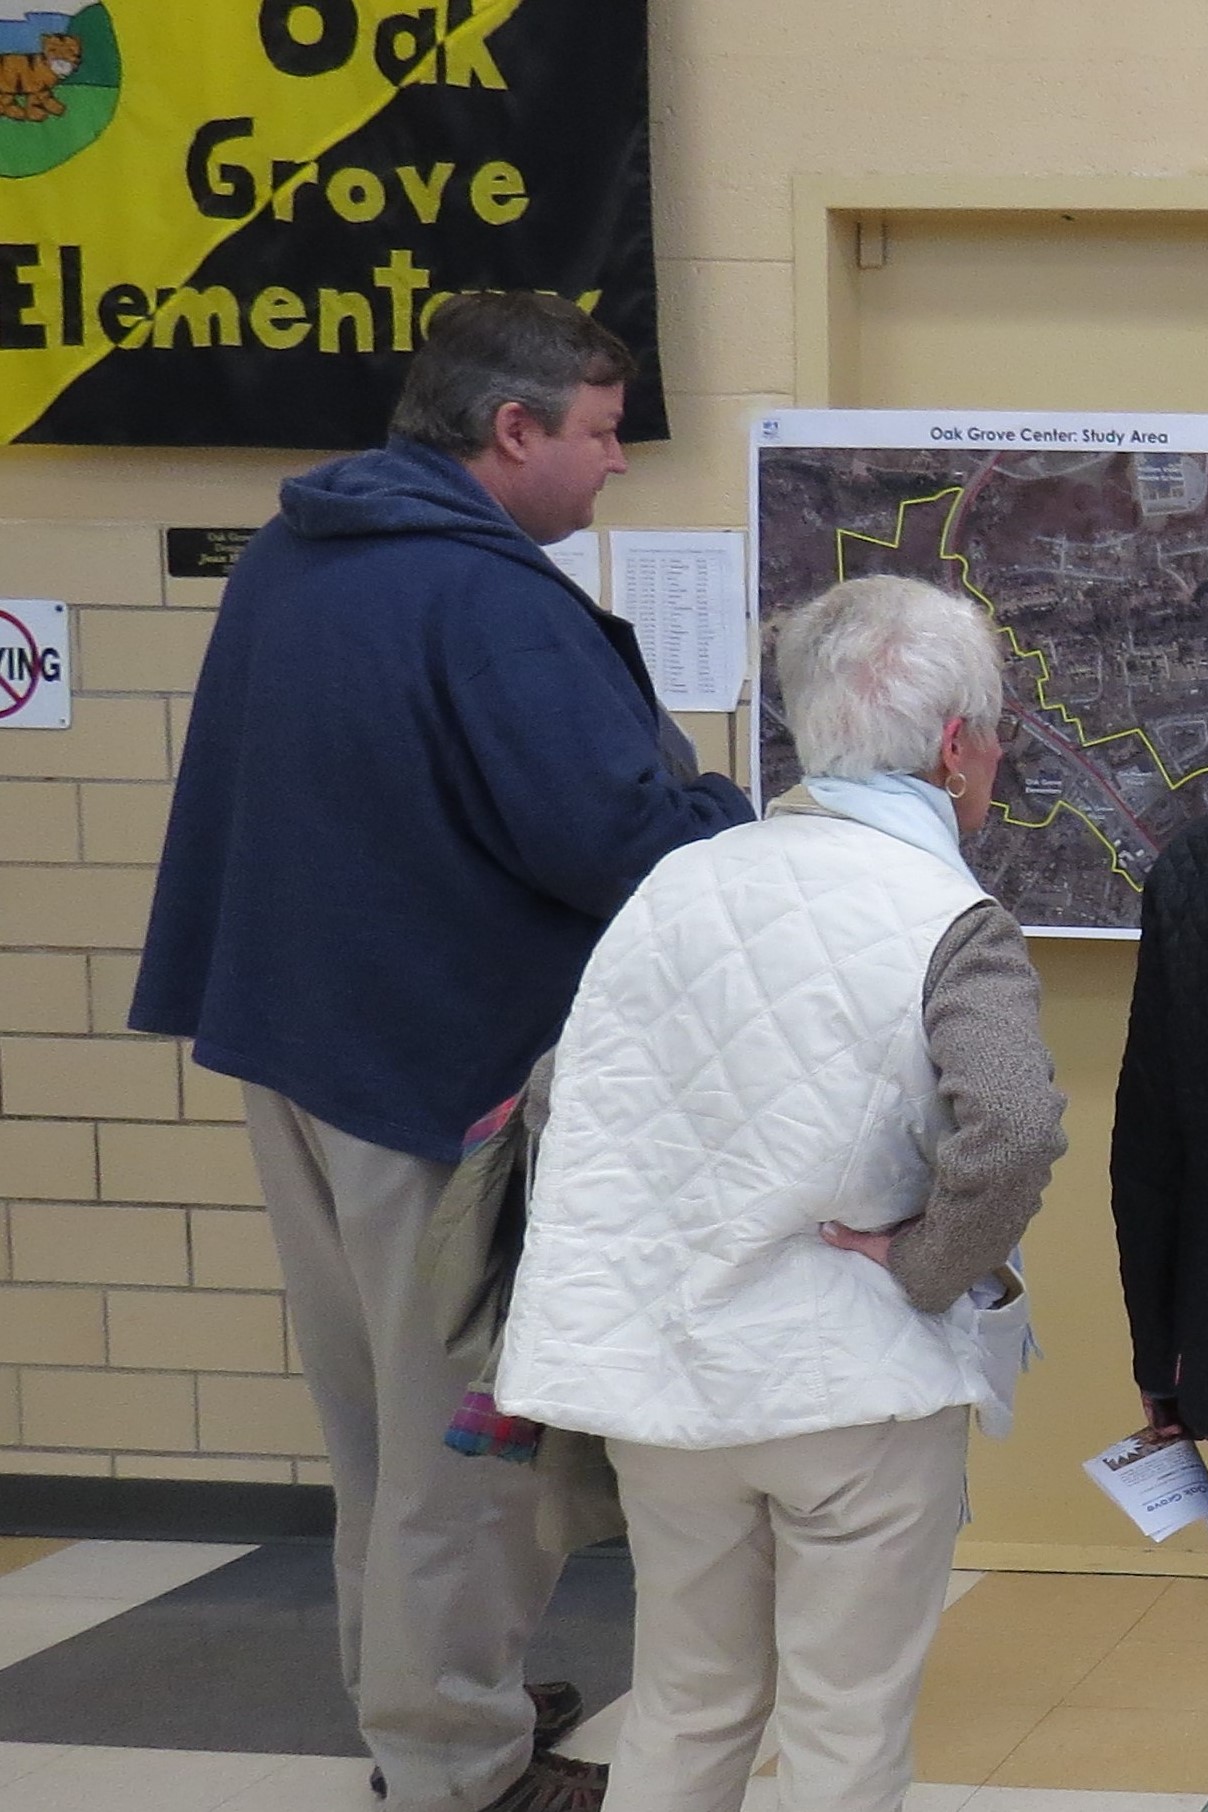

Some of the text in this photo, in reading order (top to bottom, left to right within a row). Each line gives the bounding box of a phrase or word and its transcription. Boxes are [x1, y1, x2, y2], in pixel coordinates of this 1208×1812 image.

[259, 0, 511, 90] Oak
[186, 115, 530, 225] Grove
[0, 244, 602, 352] Element
[930, 426, 1168, 446] Oak Grove Center: Study Area
[1146, 1484, 1207, 1513] Oak Grove
